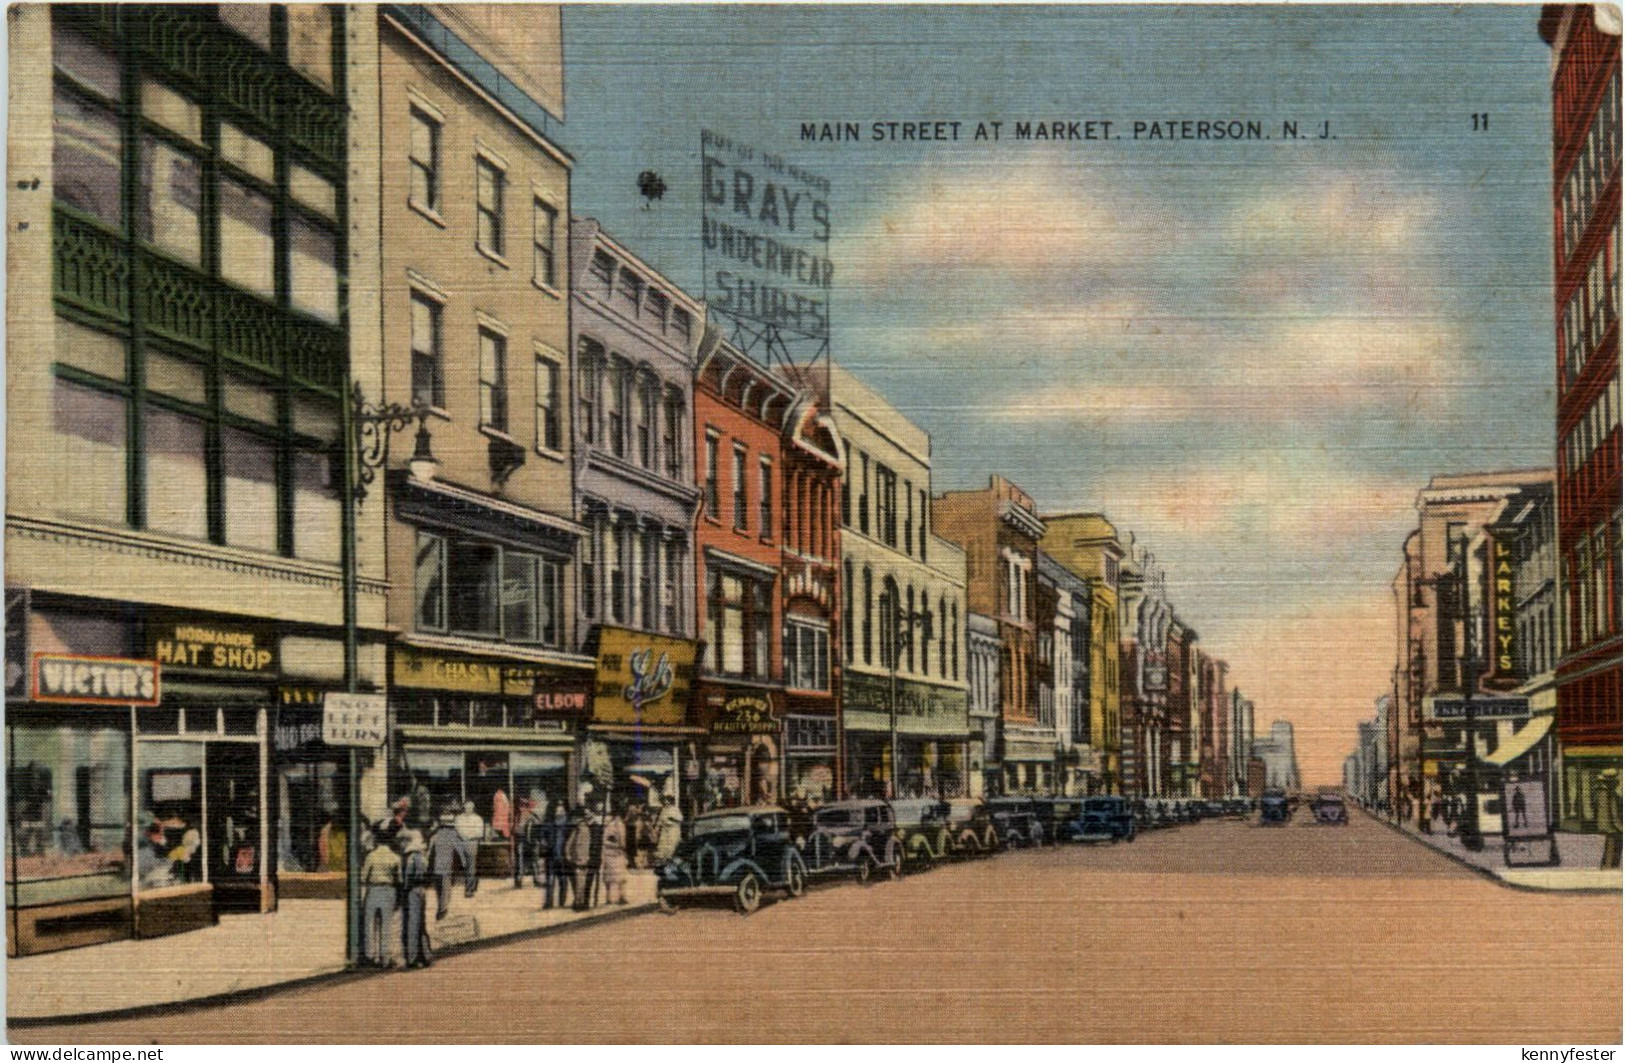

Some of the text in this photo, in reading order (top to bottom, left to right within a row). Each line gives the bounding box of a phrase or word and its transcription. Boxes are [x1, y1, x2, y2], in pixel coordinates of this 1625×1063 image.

[705, 156, 832, 242] GRAY'S
[702, 216, 835, 289] UNDERWEAR
[157, 640, 271, 670] HAT SHOP
[538, 692, 586, 710] ELBOW
[328, 712, 379, 726] LEFT
[331, 728, 380, 741] TURN
